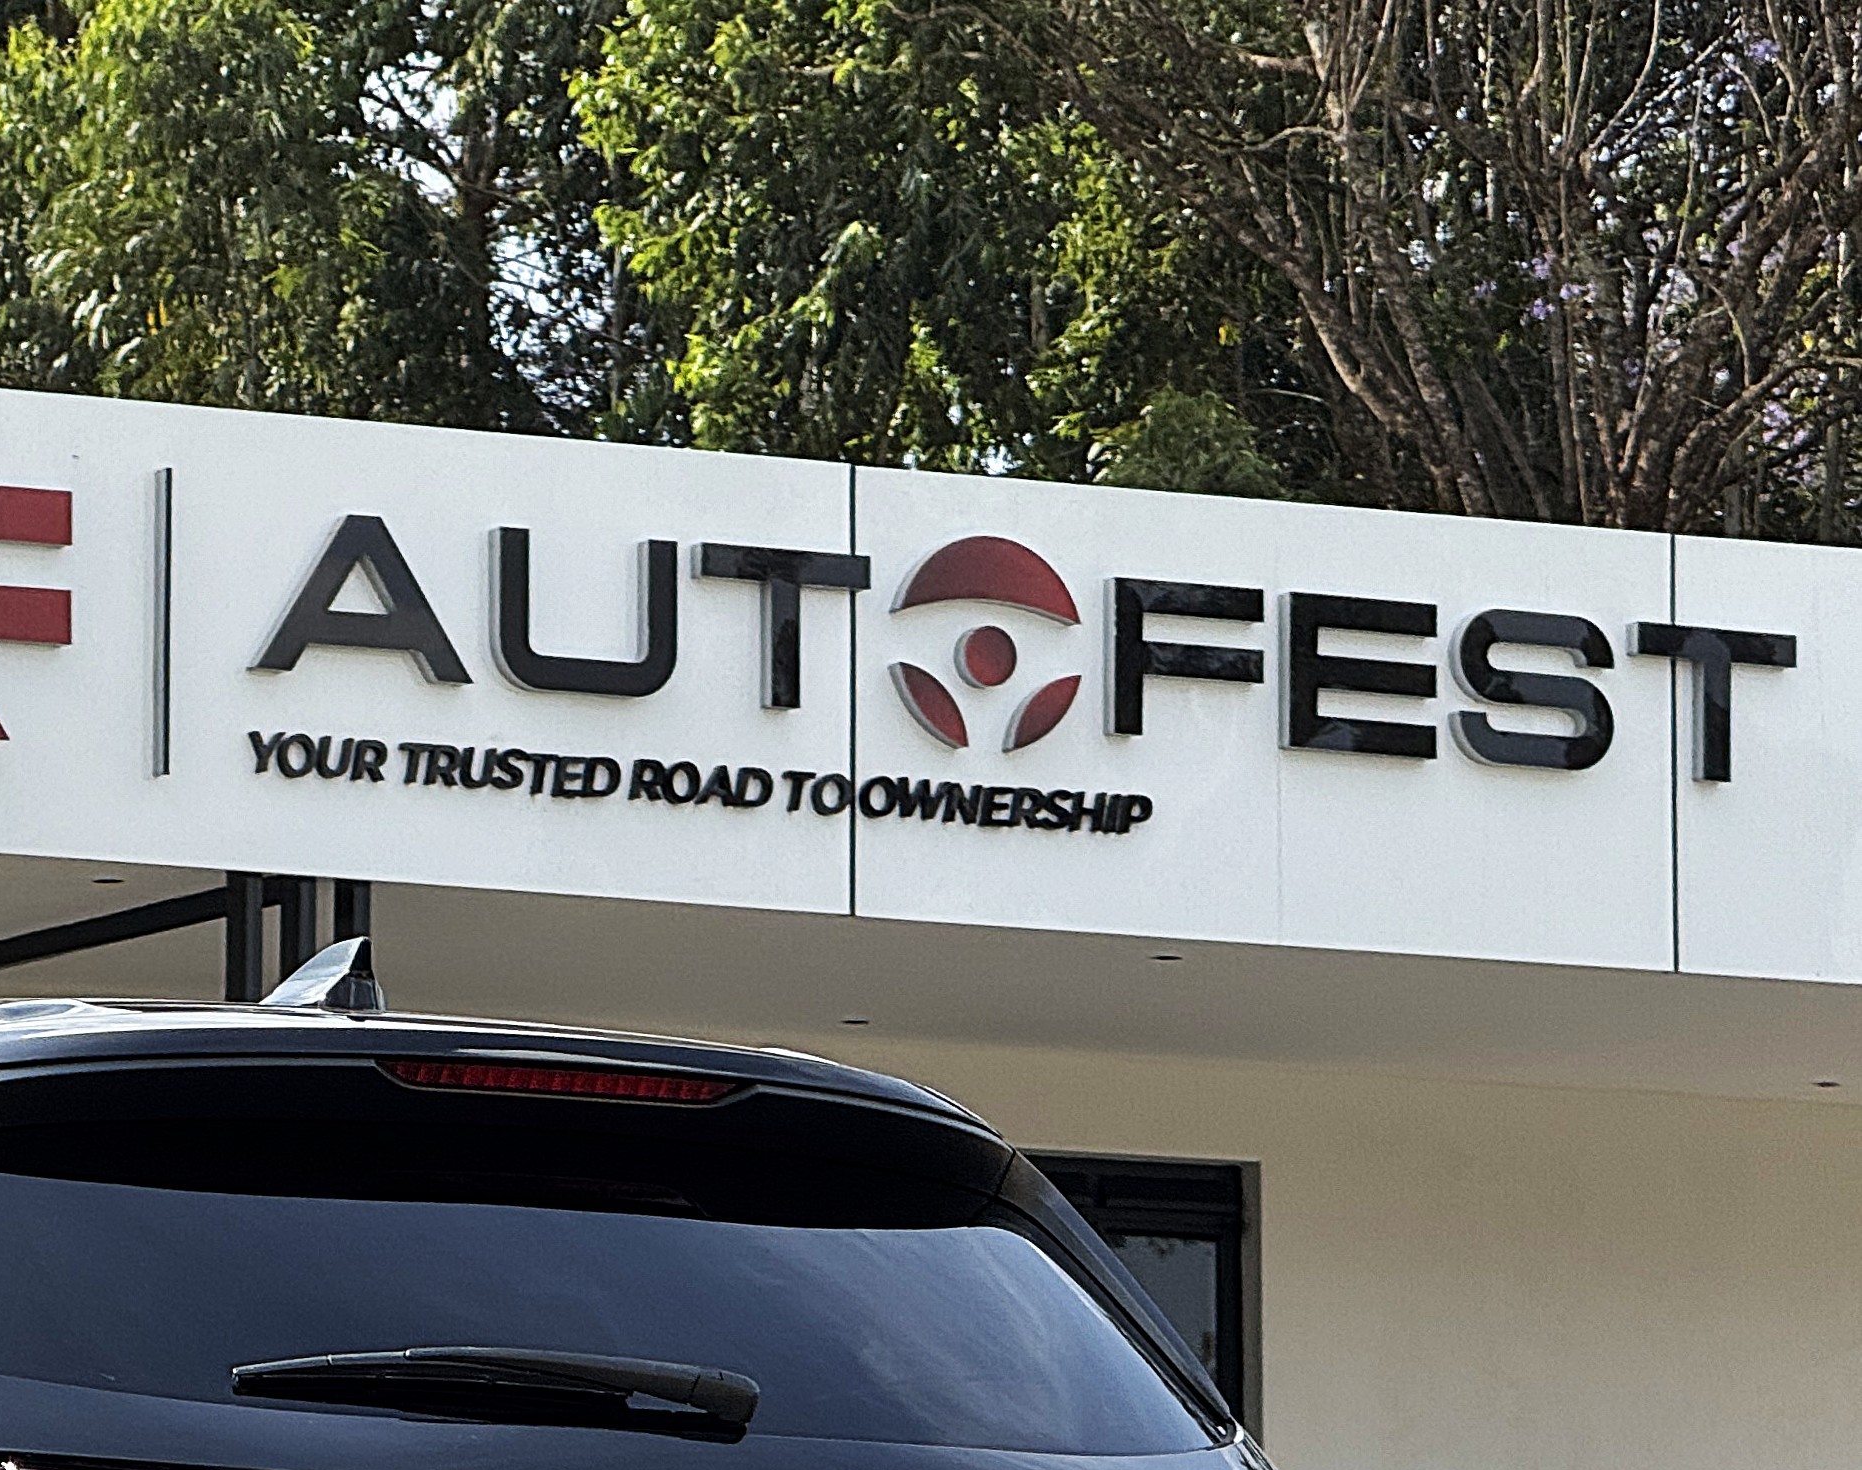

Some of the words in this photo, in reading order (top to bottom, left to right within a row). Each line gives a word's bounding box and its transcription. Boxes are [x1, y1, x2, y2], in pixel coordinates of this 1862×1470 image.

[247, 730, 388, 783] YOUR
[398, 741, 621, 798] TRUSTED
[627, 758, 773, 808] ROAD
[781, 770, 851, 816] TO
[858, 776, 1153, 835] OWNERSHIP
